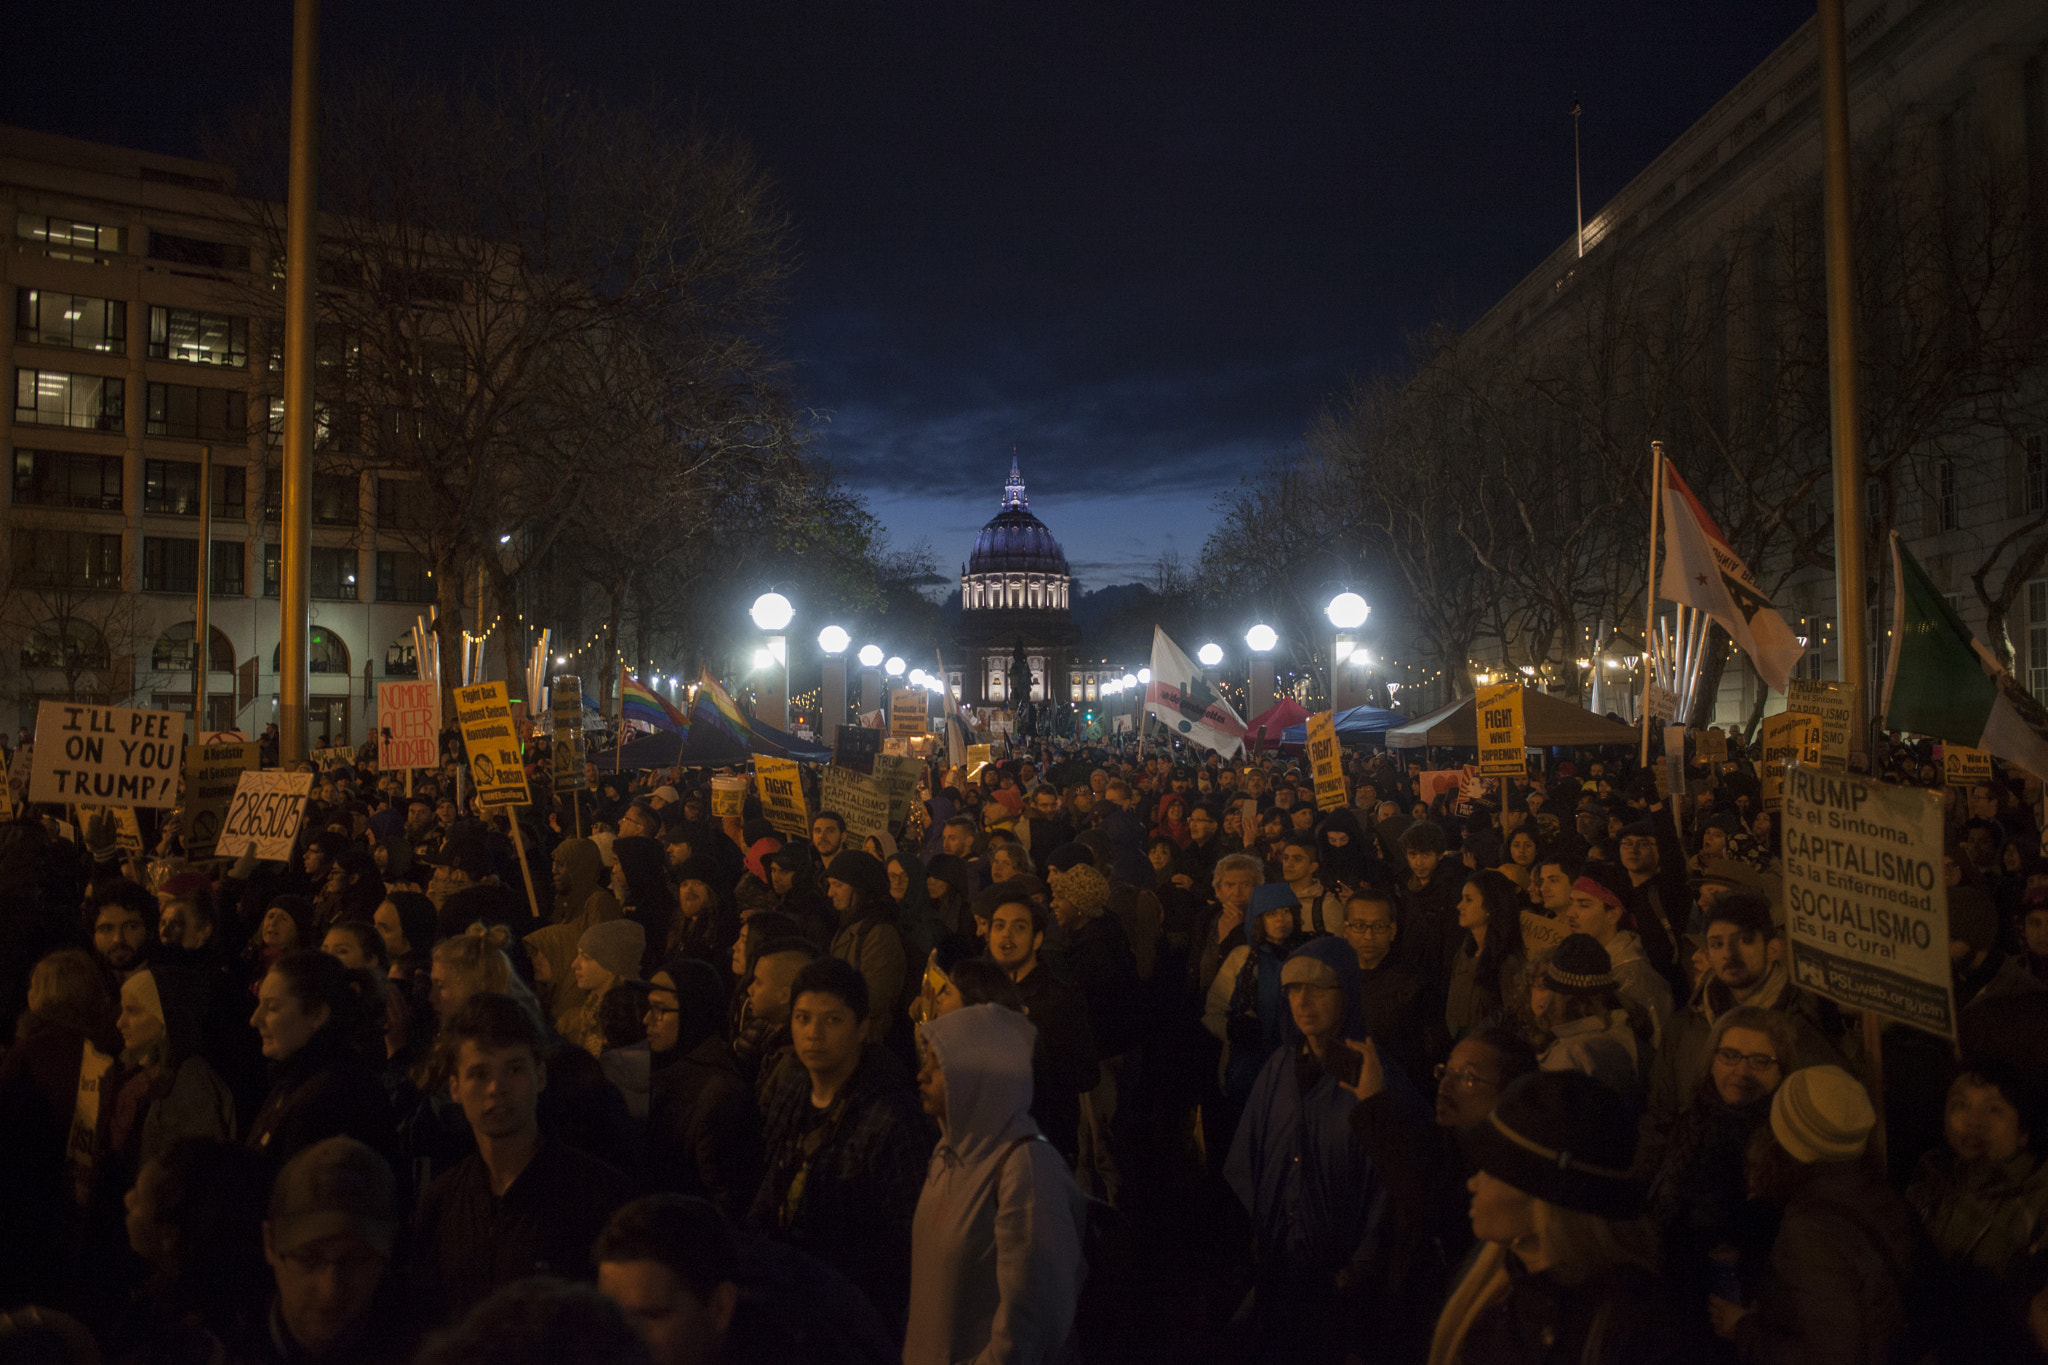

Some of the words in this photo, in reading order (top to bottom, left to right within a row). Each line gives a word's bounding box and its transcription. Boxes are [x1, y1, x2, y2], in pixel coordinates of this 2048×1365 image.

[462, 689, 481, 704] Fight
[481, 686, 497, 700] Back
[1792, 680, 1828, 694] TRUMP
[459, 708, 486, 723] Against
[1485, 708, 1512, 729] FIGHT
[1790, 703, 1850, 721] CAPITALISMO
[63, 707, 115, 733] I'LL
[130, 713, 170, 739] PEE
[381, 708, 433, 739] QUEER
[1490, 731, 1511, 744] WHITE
[65, 736, 104, 763] ON
[119, 739, 175, 770] YOU
[210, 747, 244, 760] Resistir
[512, 750, 520, 764] &
[1312, 738, 1333, 762] FIGHT
[1481, 748, 1522, 762] SUPREMACY!
[1966, 754, 1981, 763] War
[496, 768, 524, 784] Racism
[826, 766, 863, 785] TRUMP
[1962, 764, 1990, 774] Racism
[53, 769, 170, 800] TRUMP!
[764, 776, 793, 796] FIGHT
[1790, 770, 1868, 812] TRUMP
[770, 796, 793, 808] WHITE
[824, 786, 886, 811] CAPITALISMO
[226, 792, 306, 840] 2,865,075
[824, 803, 882, 830] SOCIALISMO
[1787, 799, 1802, 819] Es
[1807, 809, 1821, 825] el
[1787, 828, 1935, 891] CAPITALISMO
[1788, 858, 1804, 878] Es
[1808, 865, 1821, 883] la
[1826, 870, 1936, 913] Enfermedad.
[1790, 884, 1931, 950] SOCIALISMO
[1792, 917, 1816, 937] ¡Es
[1822, 925, 1837, 943] la
[1844, 931, 1896, 960] Cura!
